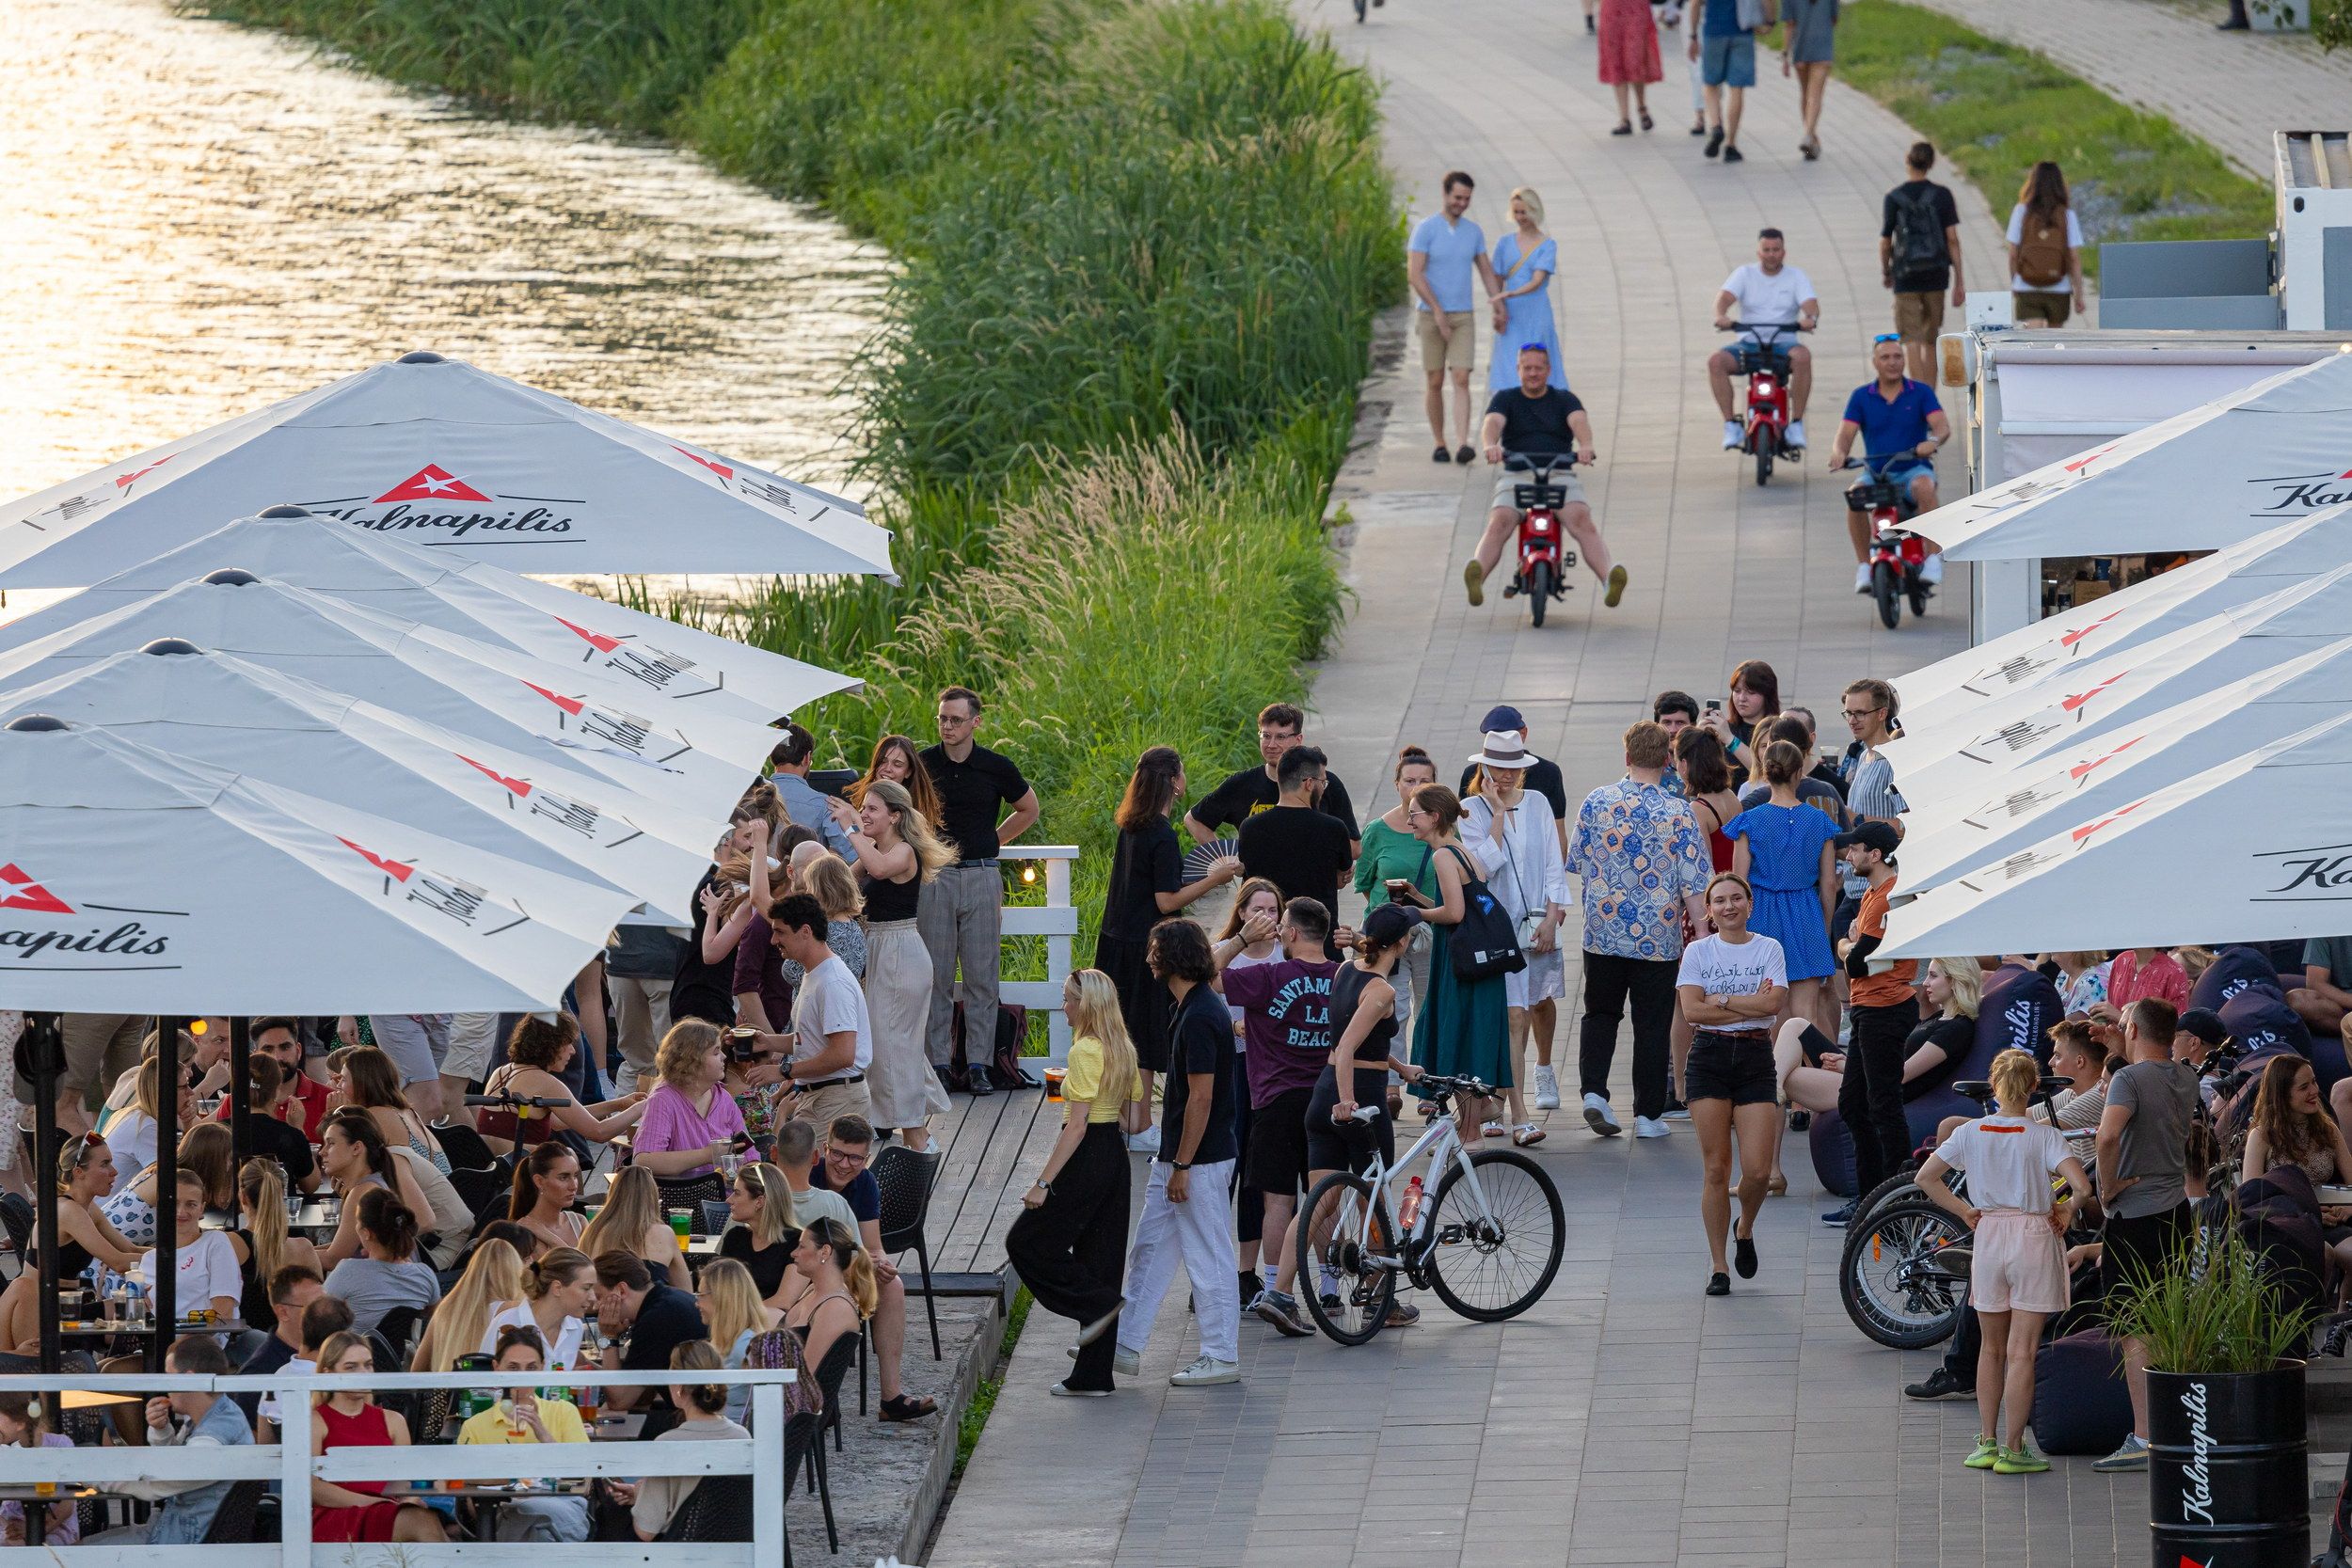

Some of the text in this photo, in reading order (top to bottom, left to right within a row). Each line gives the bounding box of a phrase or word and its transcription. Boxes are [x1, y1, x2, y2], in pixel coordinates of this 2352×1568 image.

[1267, 975, 1332, 1020] SANTAM
[1287, 1027, 1332, 1047] BEAC
[2180, 1382, 2217, 1528] Kalnapilis
